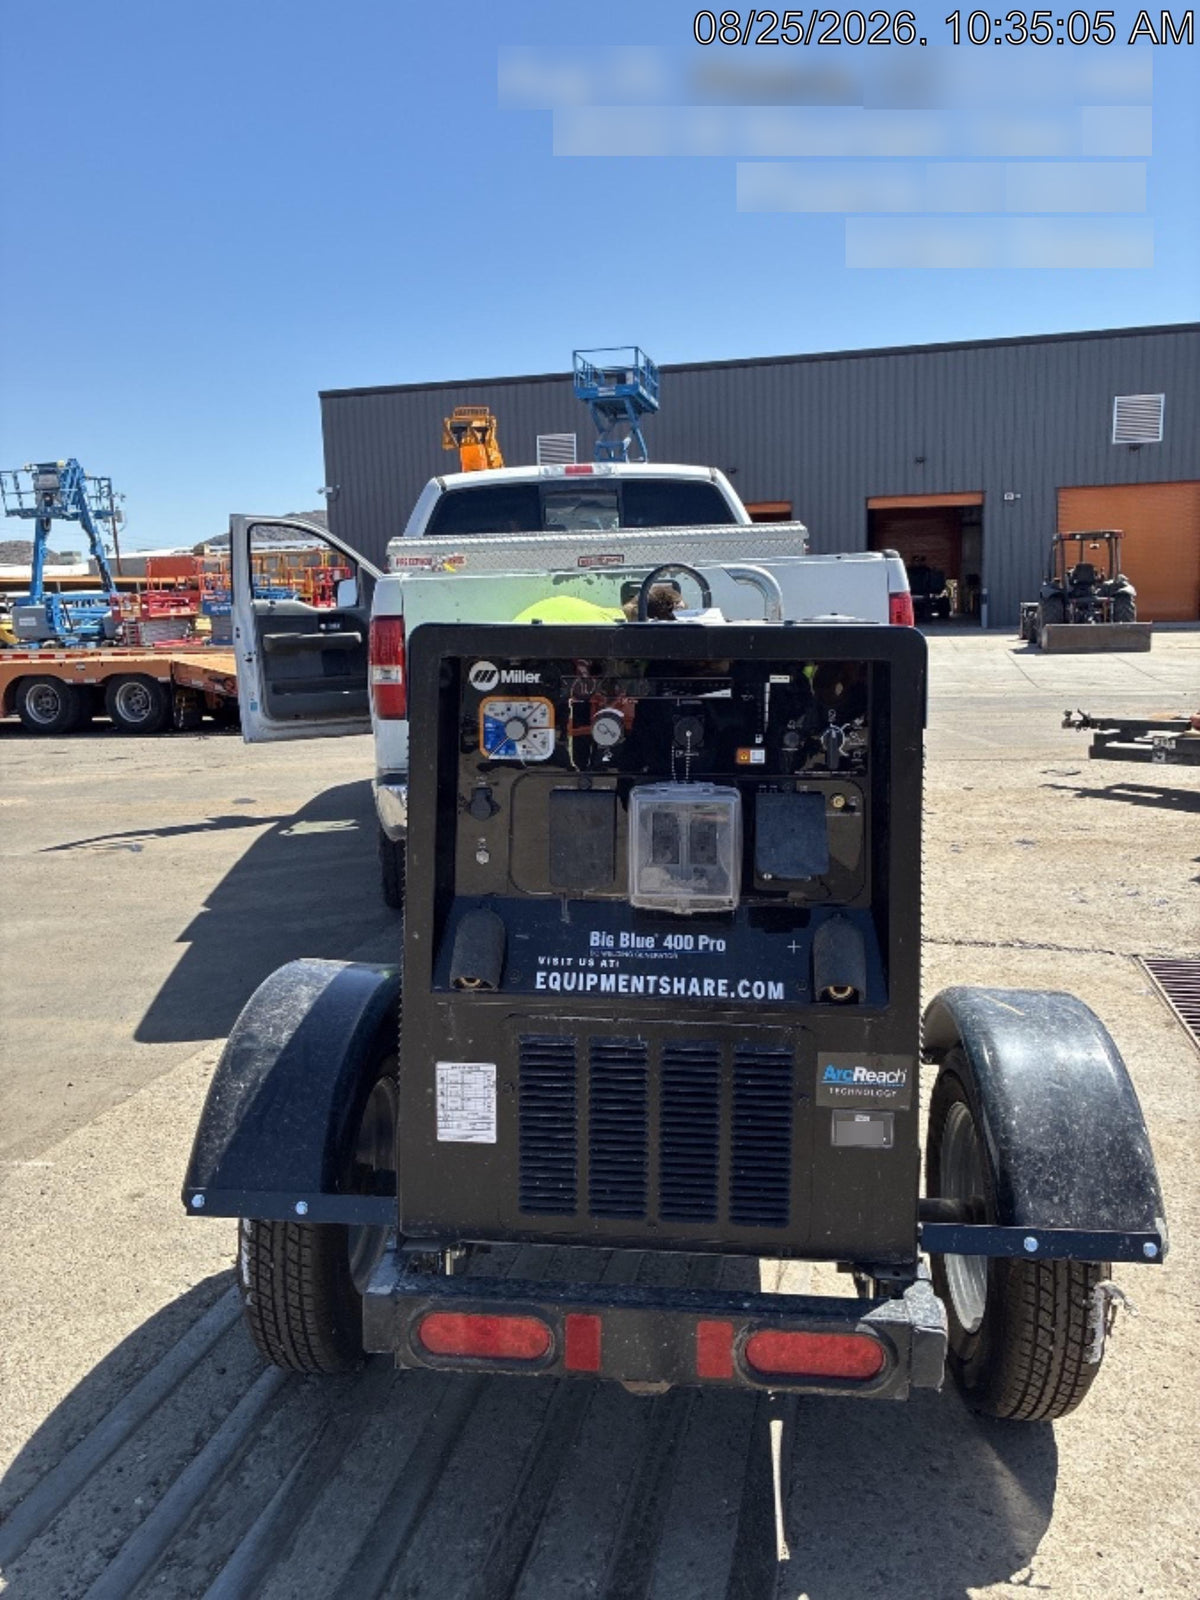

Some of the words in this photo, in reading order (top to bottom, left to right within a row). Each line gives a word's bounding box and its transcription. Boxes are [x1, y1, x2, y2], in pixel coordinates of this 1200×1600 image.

[501, 669, 541, 684] Miller
[589, 931, 615, 948] Big
[663, 934, 694, 951] 400
[698, 935, 726, 952] Pro
[538, 956, 573, 967] VISIT
[579, 958, 595, 968] US
[600, 959, 620, 968] AT:
[535, 971, 785, 1000] EQUIPMENTSHARE.COM
[823, 1064, 907, 1084] ArcReach
[829, 1087, 898, 1098] TECHNOLOGY
